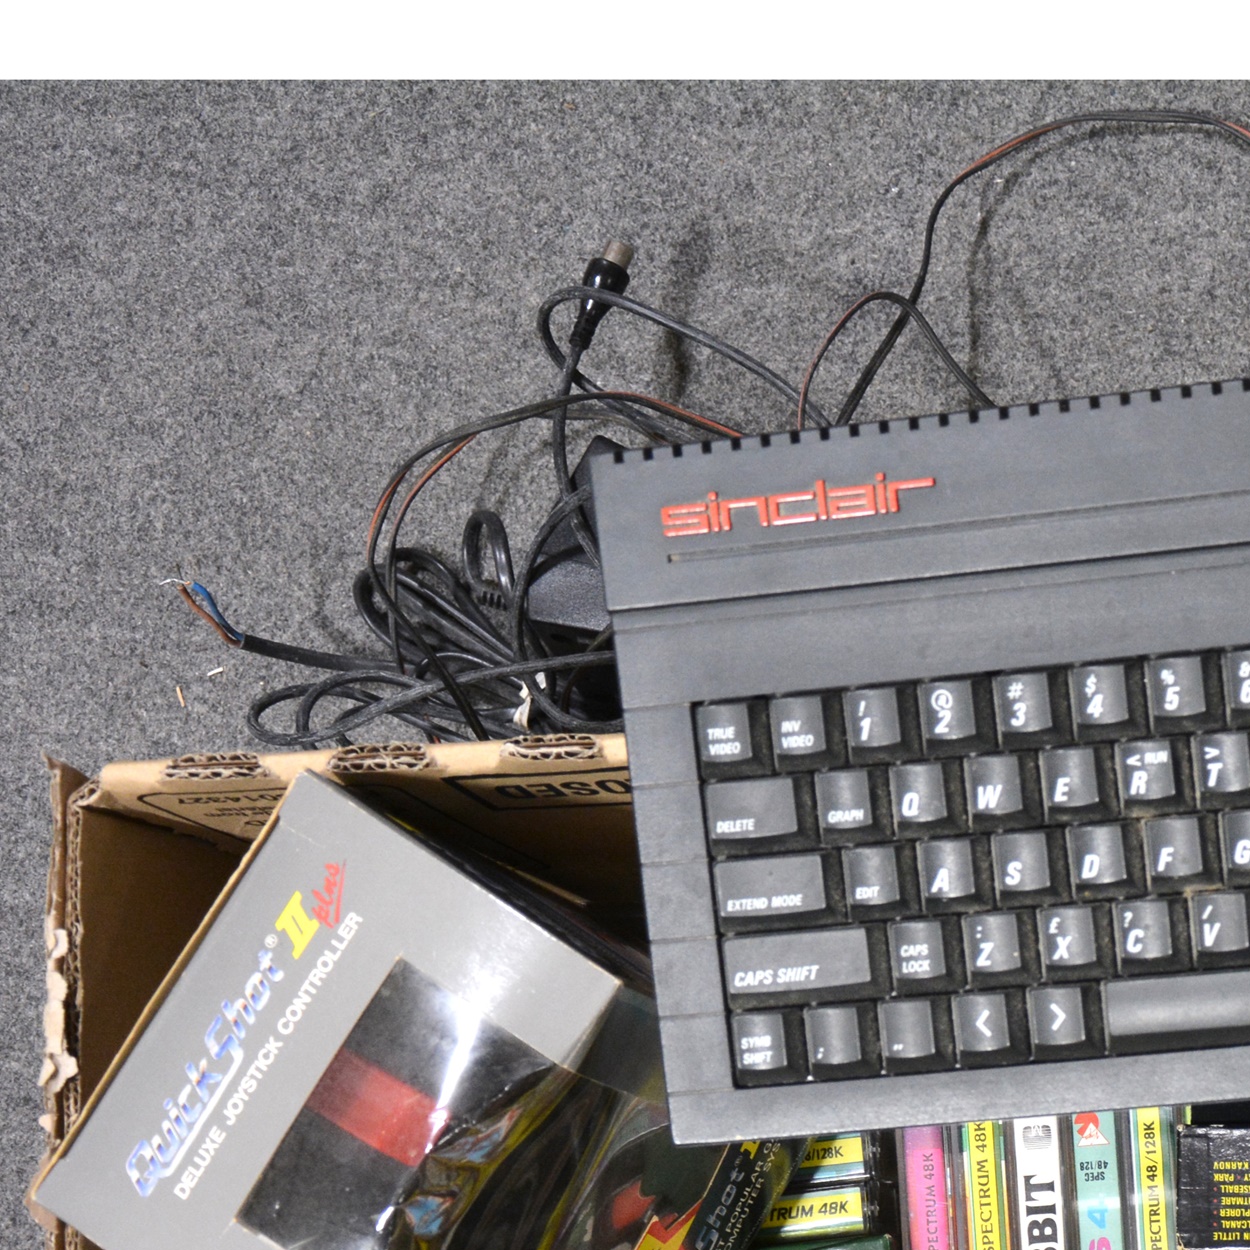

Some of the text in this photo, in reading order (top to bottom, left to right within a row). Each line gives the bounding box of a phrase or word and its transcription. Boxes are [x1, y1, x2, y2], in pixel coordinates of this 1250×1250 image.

[660, 473, 936, 538] sinclair
[707, 727, 736, 740] TRUE
[782, 721, 801, 733] INV
[782, 735, 814, 748] VIDEO
[709, 743, 741, 755] VIDEO
[828, 809, 864, 824] GRAPH
[716, 819, 755, 833] DELETE
[855, 886, 881, 898] EDIT
[727, 894, 803, 912] EXTEND MODE
[900, 945, 929, 957] CAPS
[902, 960, 931, 973] LOCK
[734, 965, 819, 988] CAPS SHIFT
[741, 1035, 771, 1050] SYMB
[174, 911, 364, 1201] DELUXE JOYSTICK CONTROLLER
[742, 1051, 773, 1065] SHIFT
[1143, 1120, 1158, 1183] 48/128K
[923, 1152, 935, 1181] 48K
[727, 1161, 763, 1234] POPULAR
[1213, 1232, 1241, 1241] LITTLE
